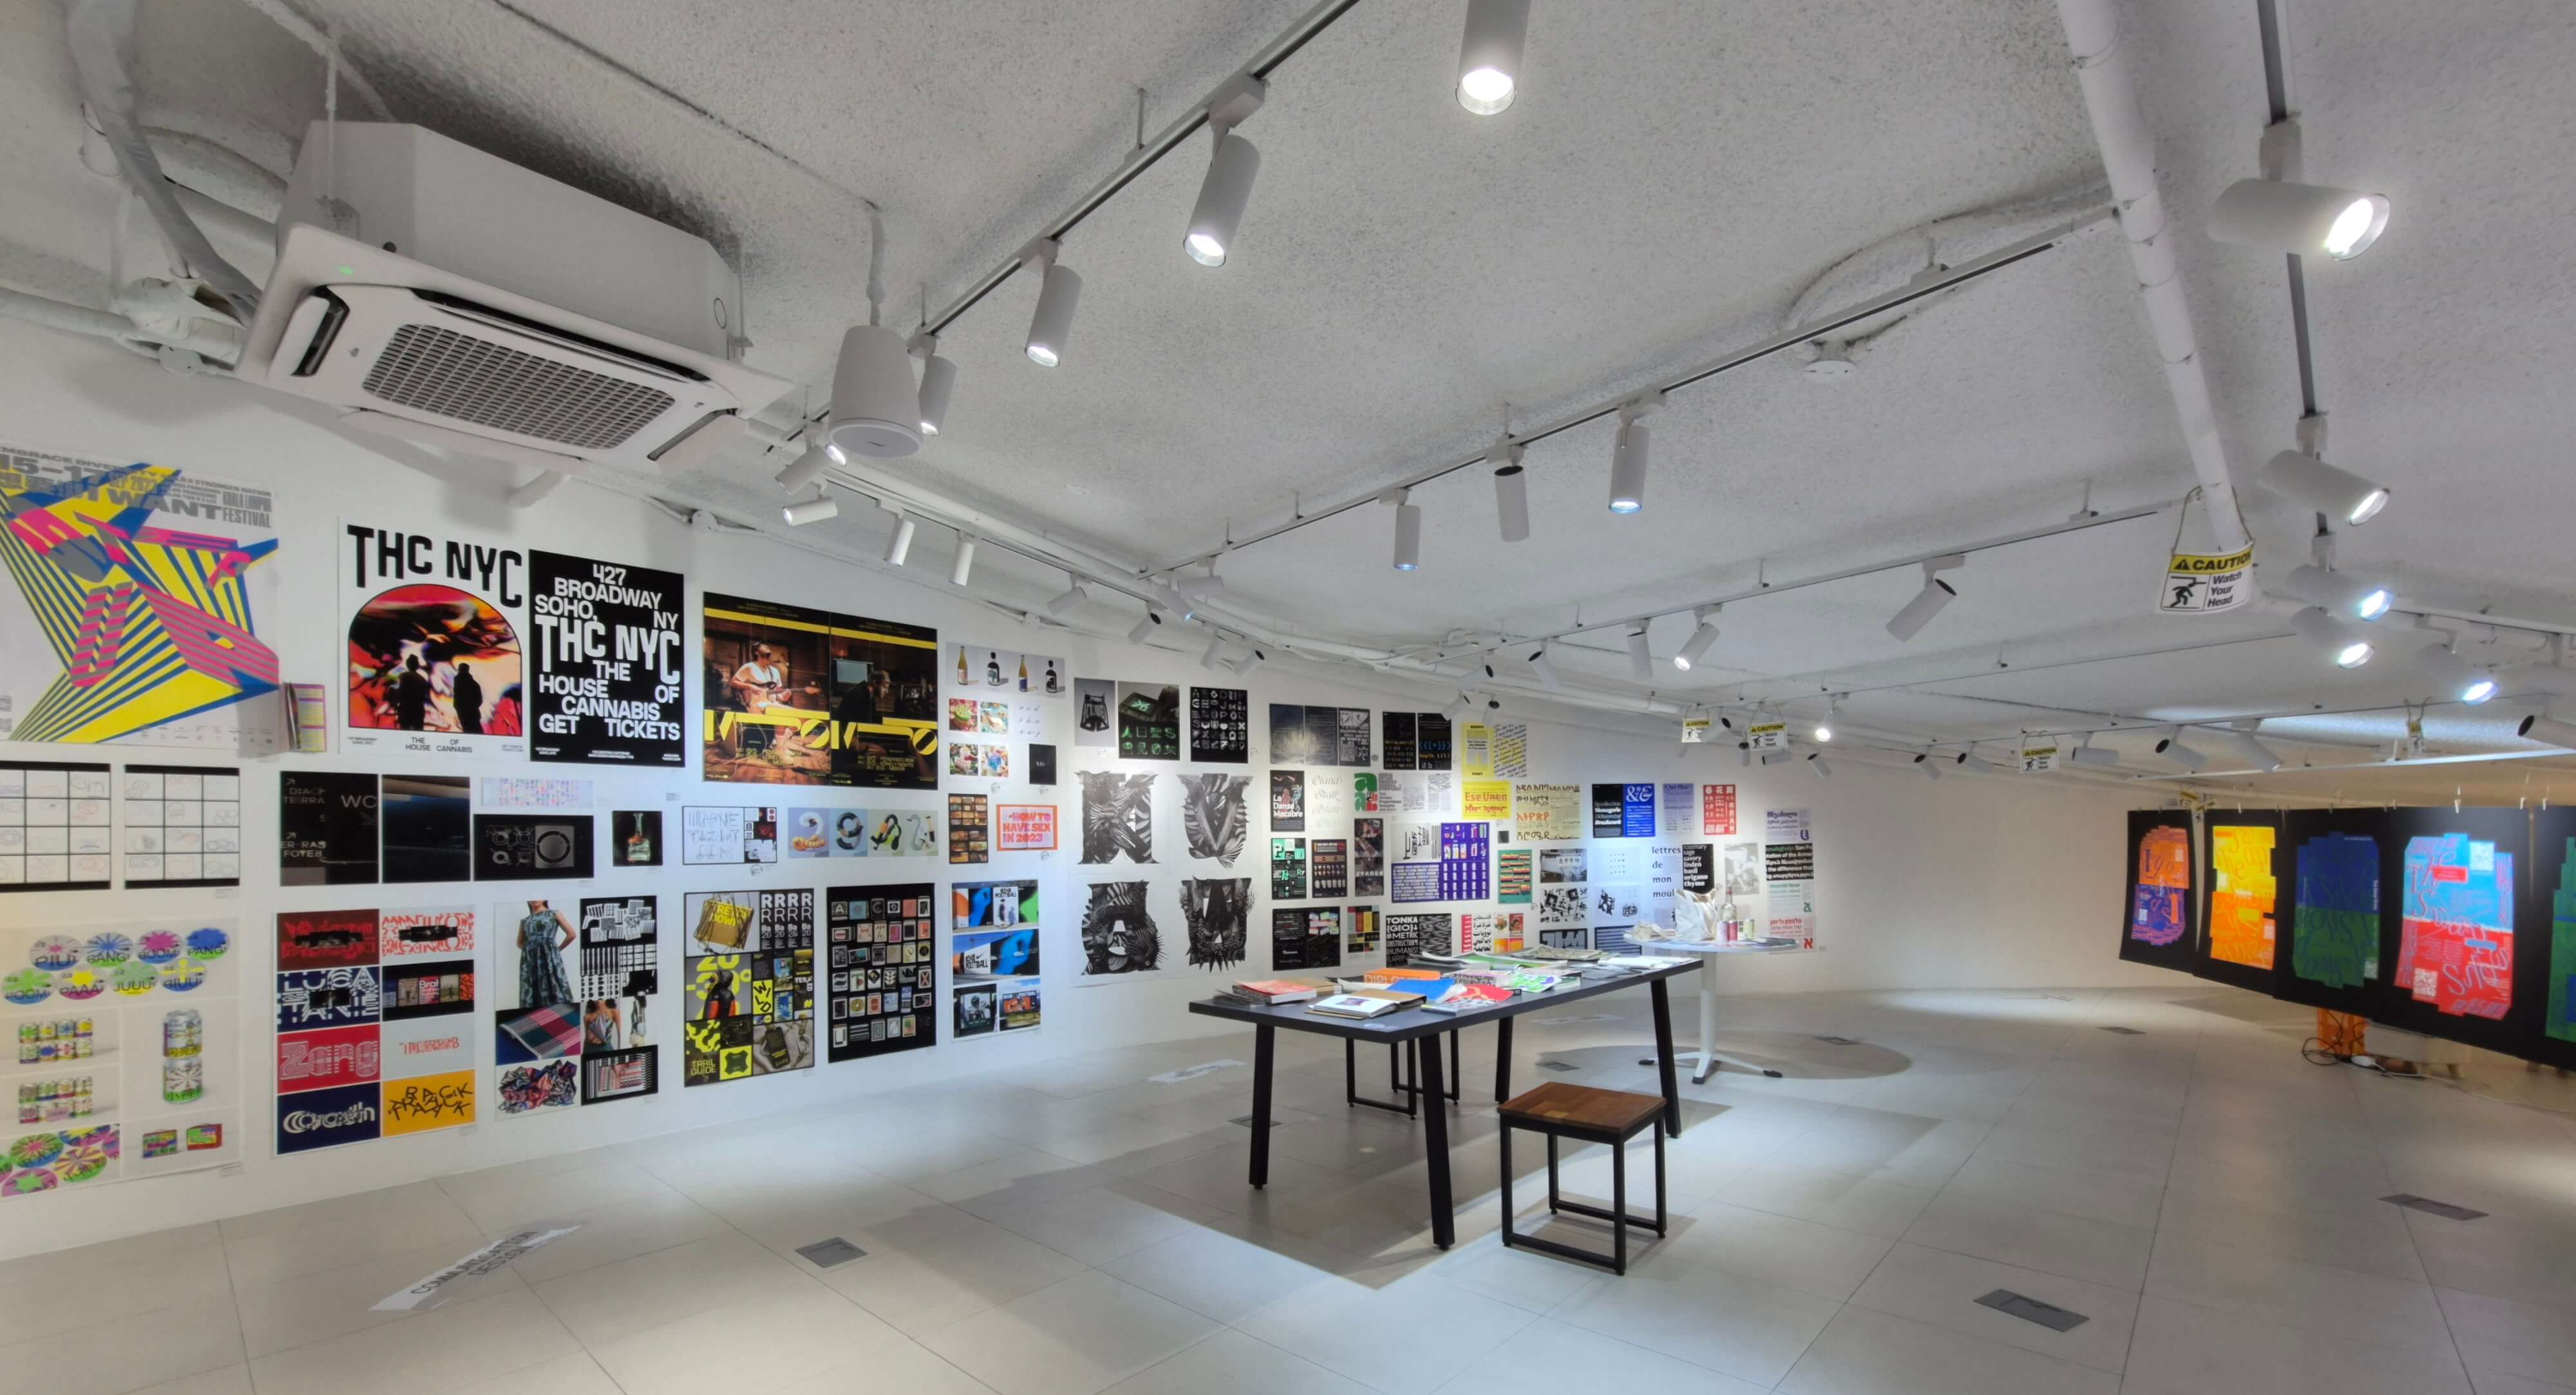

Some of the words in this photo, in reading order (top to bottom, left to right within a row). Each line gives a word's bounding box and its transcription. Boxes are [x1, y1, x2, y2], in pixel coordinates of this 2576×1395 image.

[222, 507, 271, 528] FESTIVAL
[348, 525, 432, 588] THC
[446, 540, 522, 608] NYC
[2192, 550, 2251, 571] CAUTION
[592, 564, 626, 585] 427
[2213, 571, 2242, 585] Watch
[554, 577, 662, 609] BROADWAY
[2211, 585, 2233, 597] Your
[2208, 595, 2233, 608] Head
[534, 594, 598, 623] SOHO,
[653, 610, 678, 630] NY
[534, 614, 605, 672] THC
[616, 624, 680, 685] NYC
[592, 660, 630, 682] THE
[539, 675, 608, 700] HOUSE
[654, 685, 679, 704] OF
[562, 696, 660, 721] CANNABIS
[539, 713, 580, 734] GET
[605, 718, 680, 741] TICKETS
[1038, 812, 1051, 822] TO
[1003, 822, 1030, 832] HAVE
[1031, 822, 1051, 833] SEX
[1016, 833, 1043, 843] 2023
[761, 894, 773, 908] R
[775, 894, 786, 907] R
[787, 893, 799, 907] R
[801, 892, 812, 907] R
[761, 908, 772, 923] R
[775, 907, 786, 922] R
[787, 907, 798, 921] R
[801, 907, 812, 920] R
[1387, 916, 1419, 925] TONKA
[690, 1058, 715, 1068] TRAIL
[690, 1066, 716, 1076] GUIDE
